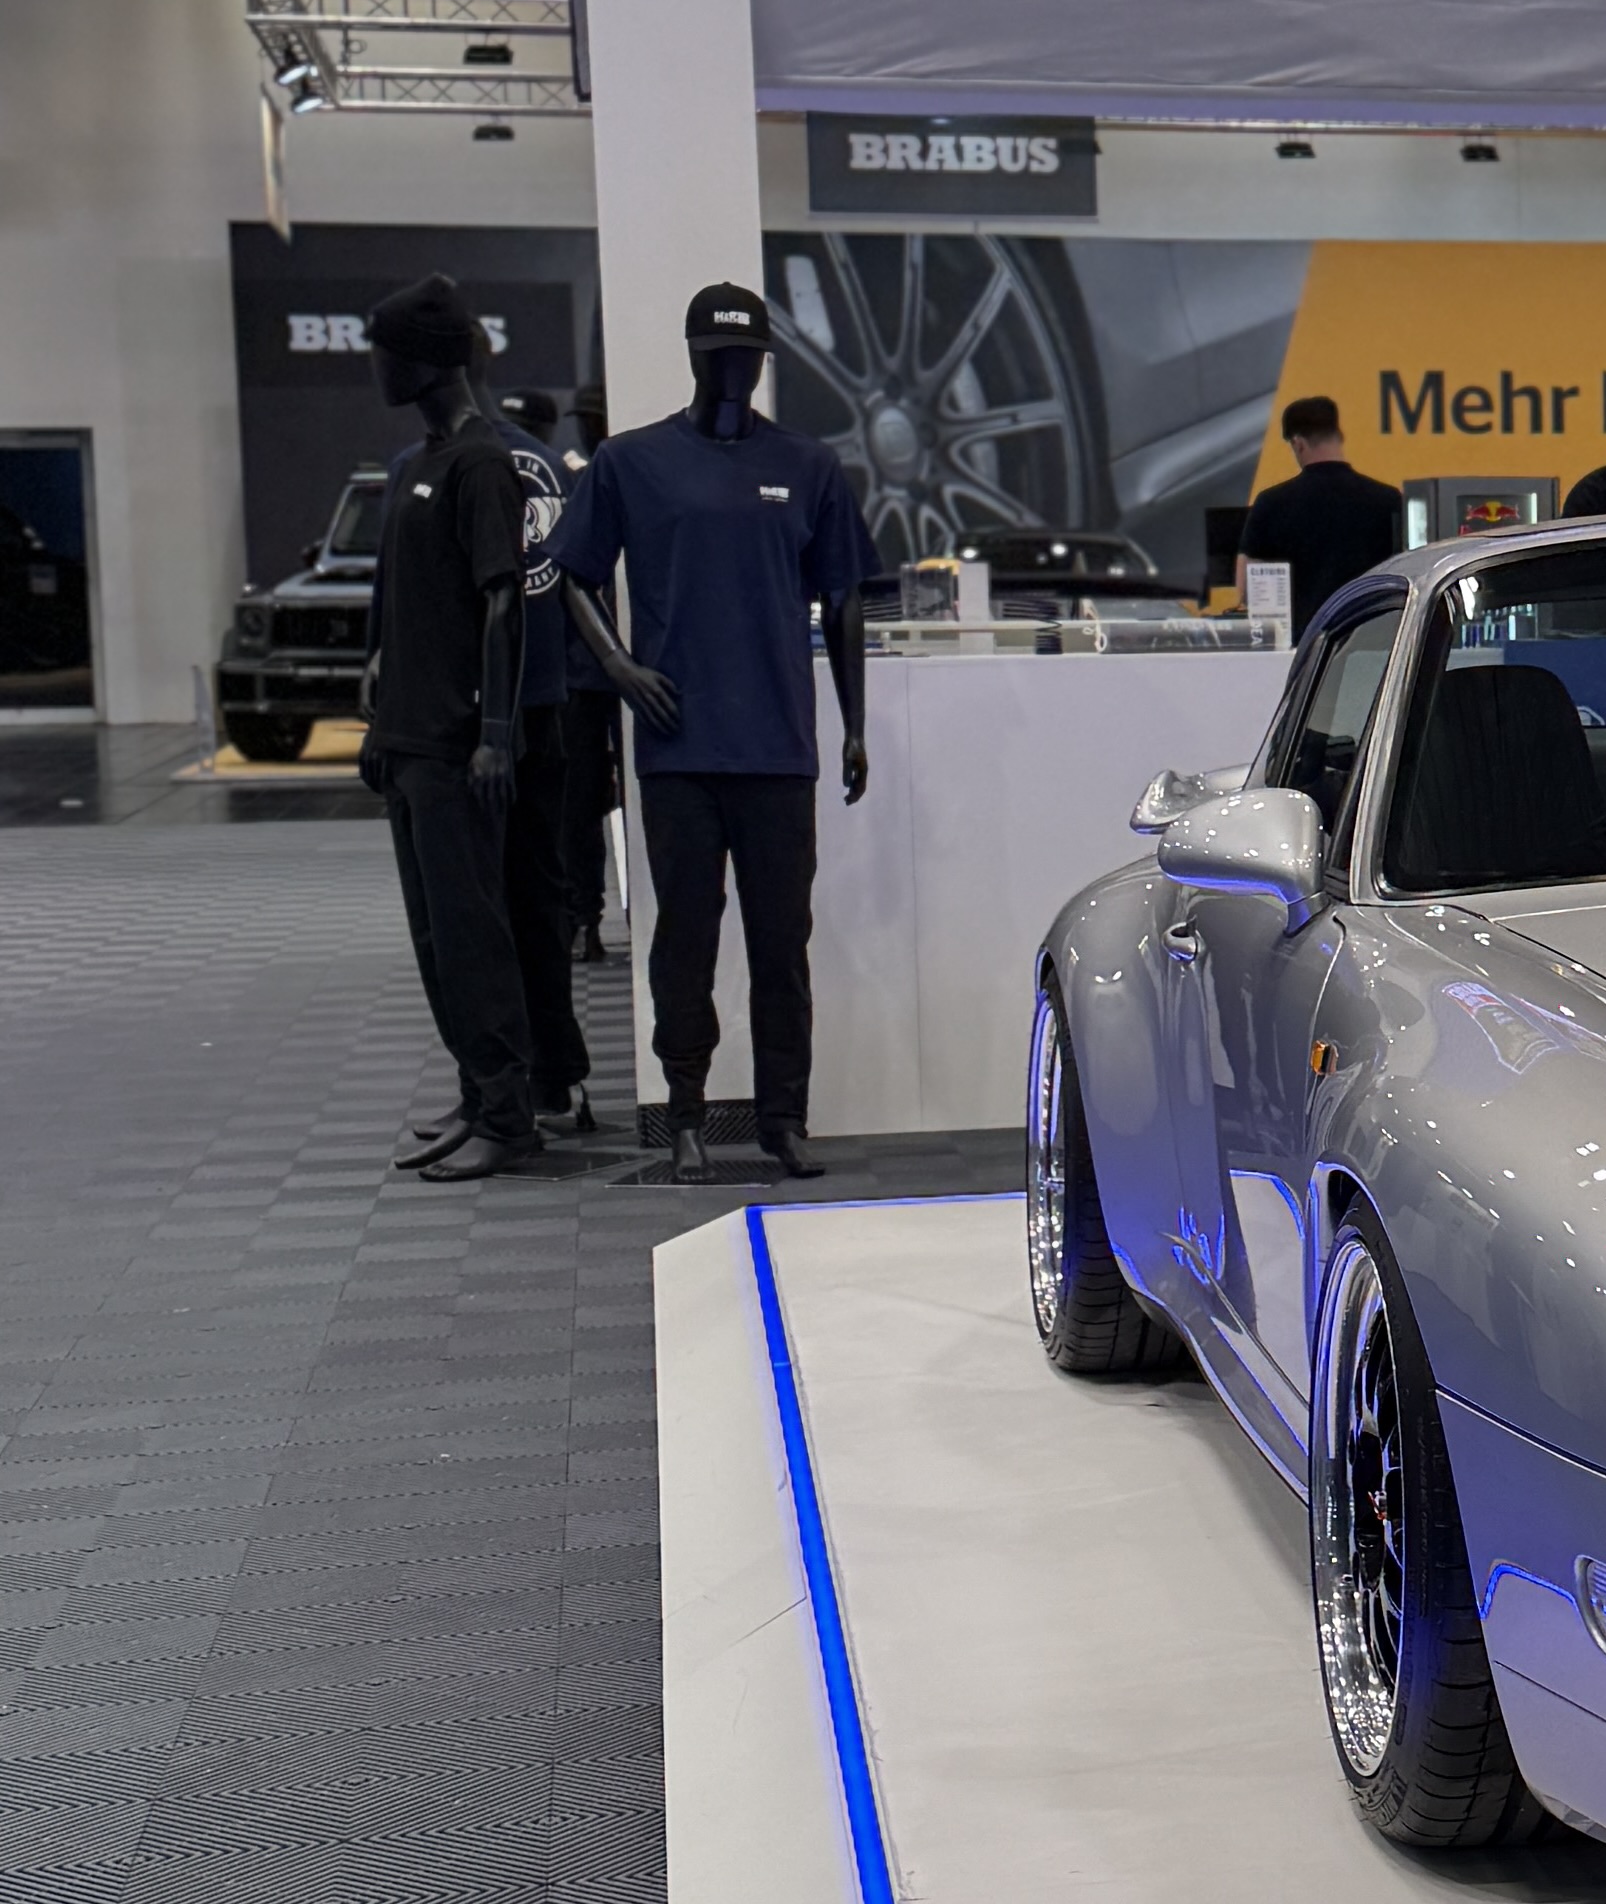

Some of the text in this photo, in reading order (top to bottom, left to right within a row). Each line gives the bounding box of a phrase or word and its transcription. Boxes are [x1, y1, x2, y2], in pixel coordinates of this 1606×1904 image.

[849, 133, 1059, 173] BRABUS
[287, 313, 508, 353] BRS
[1379, 369, 1580, 434] Mehr
